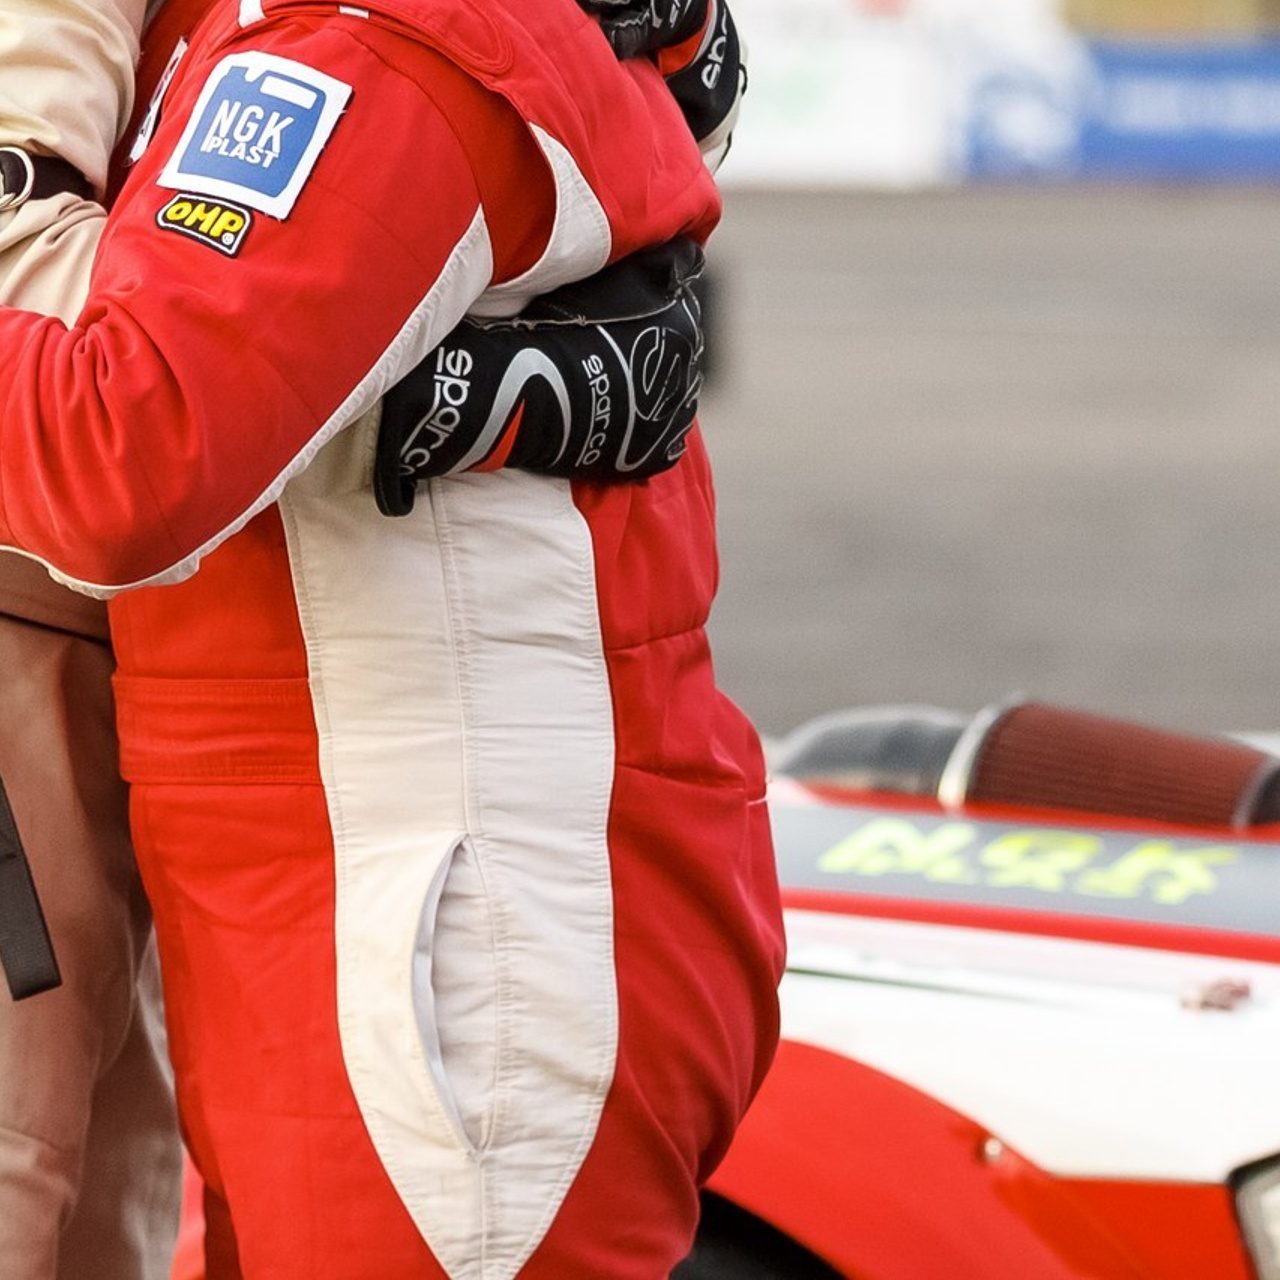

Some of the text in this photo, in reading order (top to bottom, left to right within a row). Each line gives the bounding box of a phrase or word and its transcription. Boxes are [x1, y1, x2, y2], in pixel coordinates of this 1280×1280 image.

[200, 99, 294, 154] NGK
[207, 135, 280, 169] PLAST
[165, 200, 245, 238] OMP
[577, 354, 611, 467] sparco
